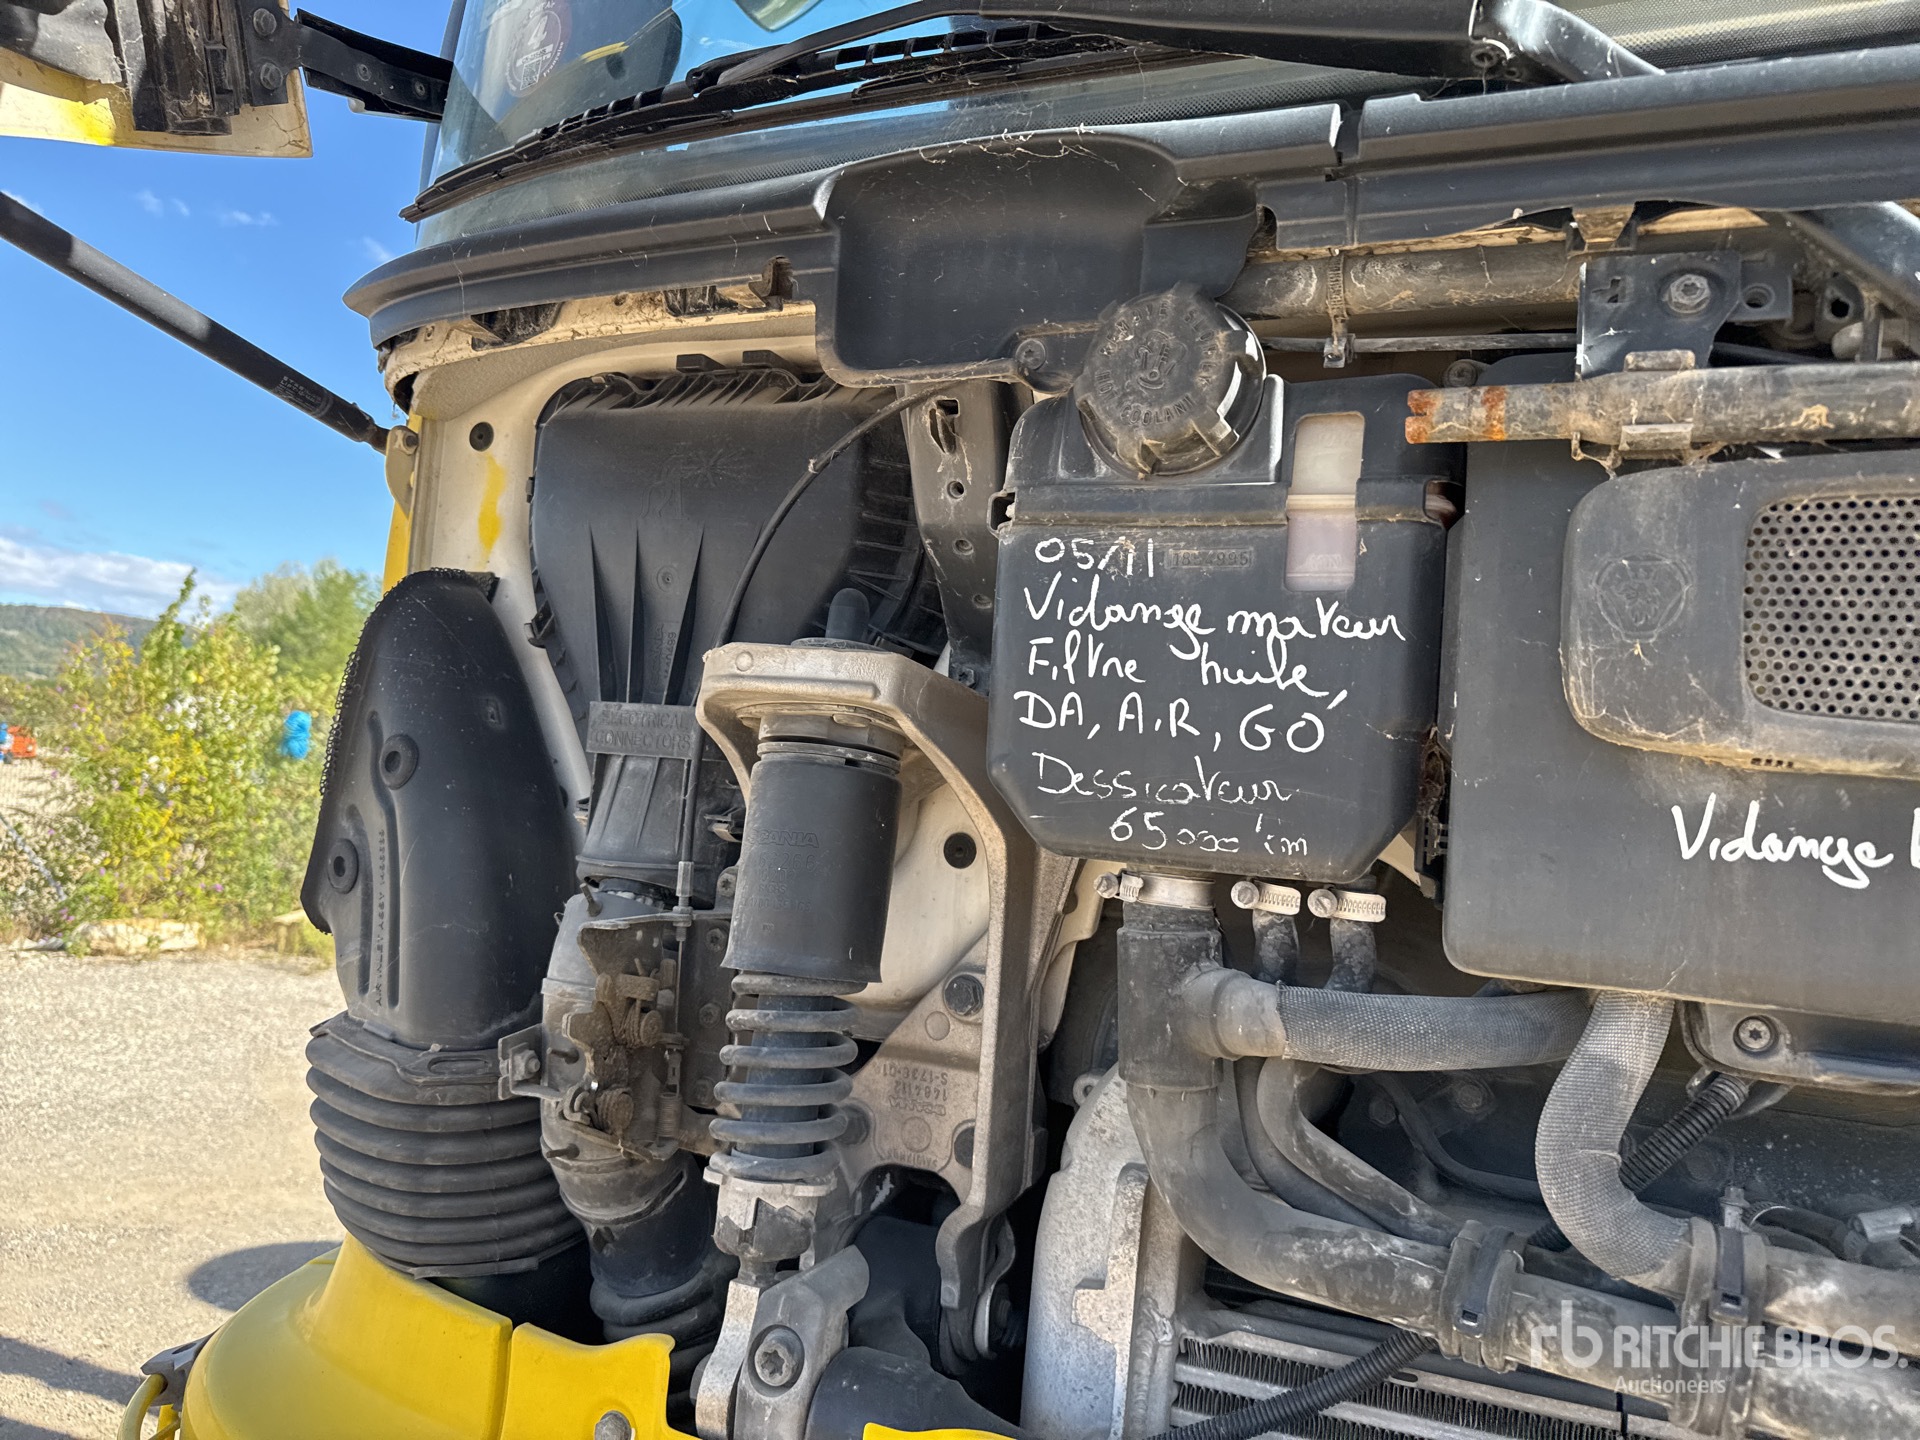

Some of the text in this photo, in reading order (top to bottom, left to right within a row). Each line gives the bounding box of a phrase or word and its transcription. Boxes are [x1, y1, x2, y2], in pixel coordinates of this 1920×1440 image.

[528, 15, 548, 49] 4
[1120, 393, 1196, 426] COOLANT
[1035, 536, 1154, 578] 05/11
[1024, 571, 1215, 660] Vidange
[602, 709, 689, 731] ELECTRICAL
[594, 729, 691, 751] CONNECTORS
[747, 827, 820, 849] SCANIA
[1671, 792, 1894, 889] Vidange
